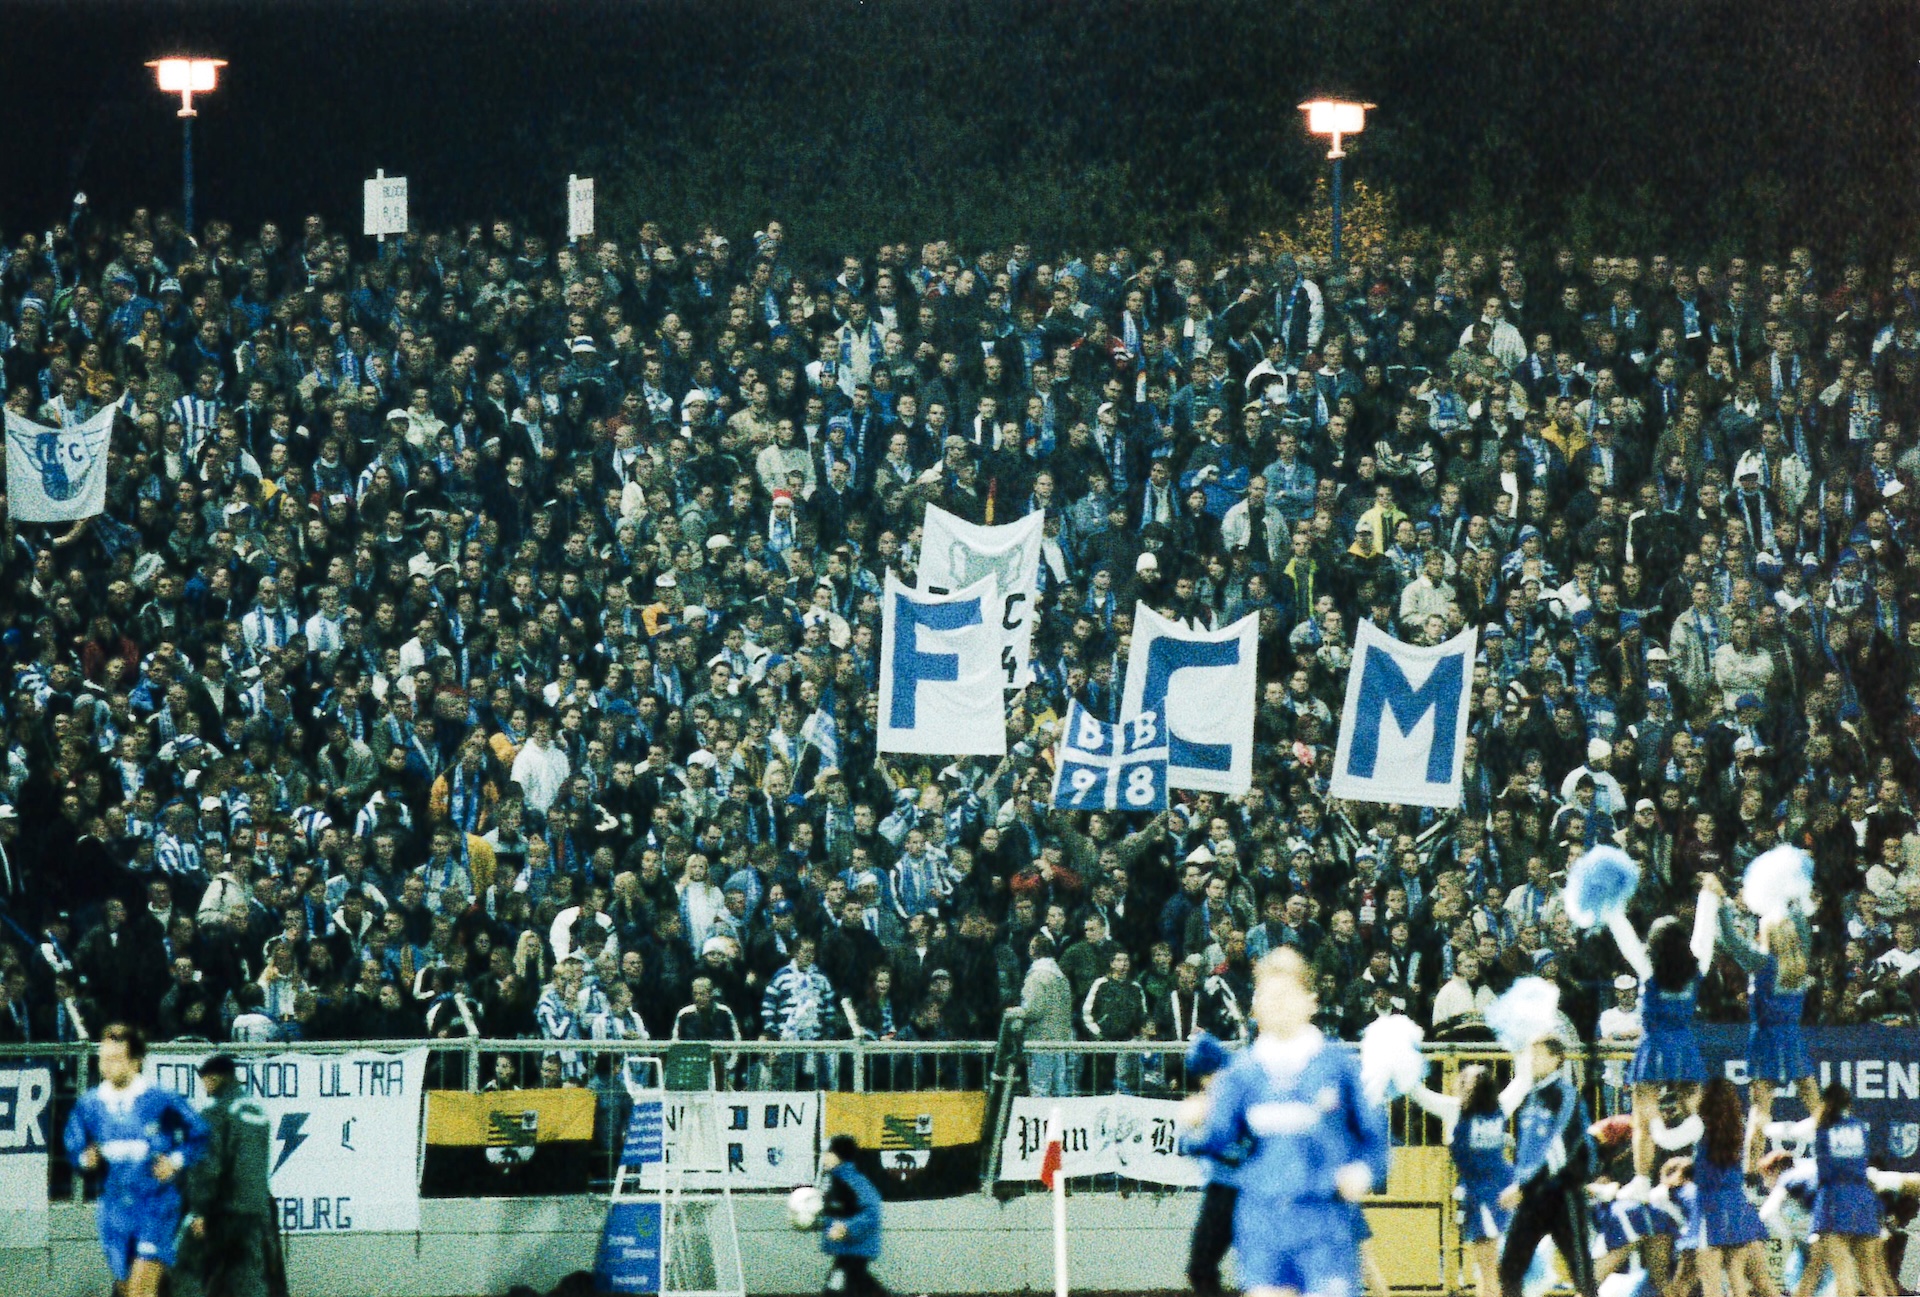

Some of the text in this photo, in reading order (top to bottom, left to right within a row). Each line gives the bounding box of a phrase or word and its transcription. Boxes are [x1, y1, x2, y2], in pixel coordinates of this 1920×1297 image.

[890, 592, 983, 729] F
[1001, 645, 1017, 683] 4
[1141, 636, 1239, 772] C
[1347, 645, 1464, 784] M
[320, 1060, 404, 1097] ULTRA
